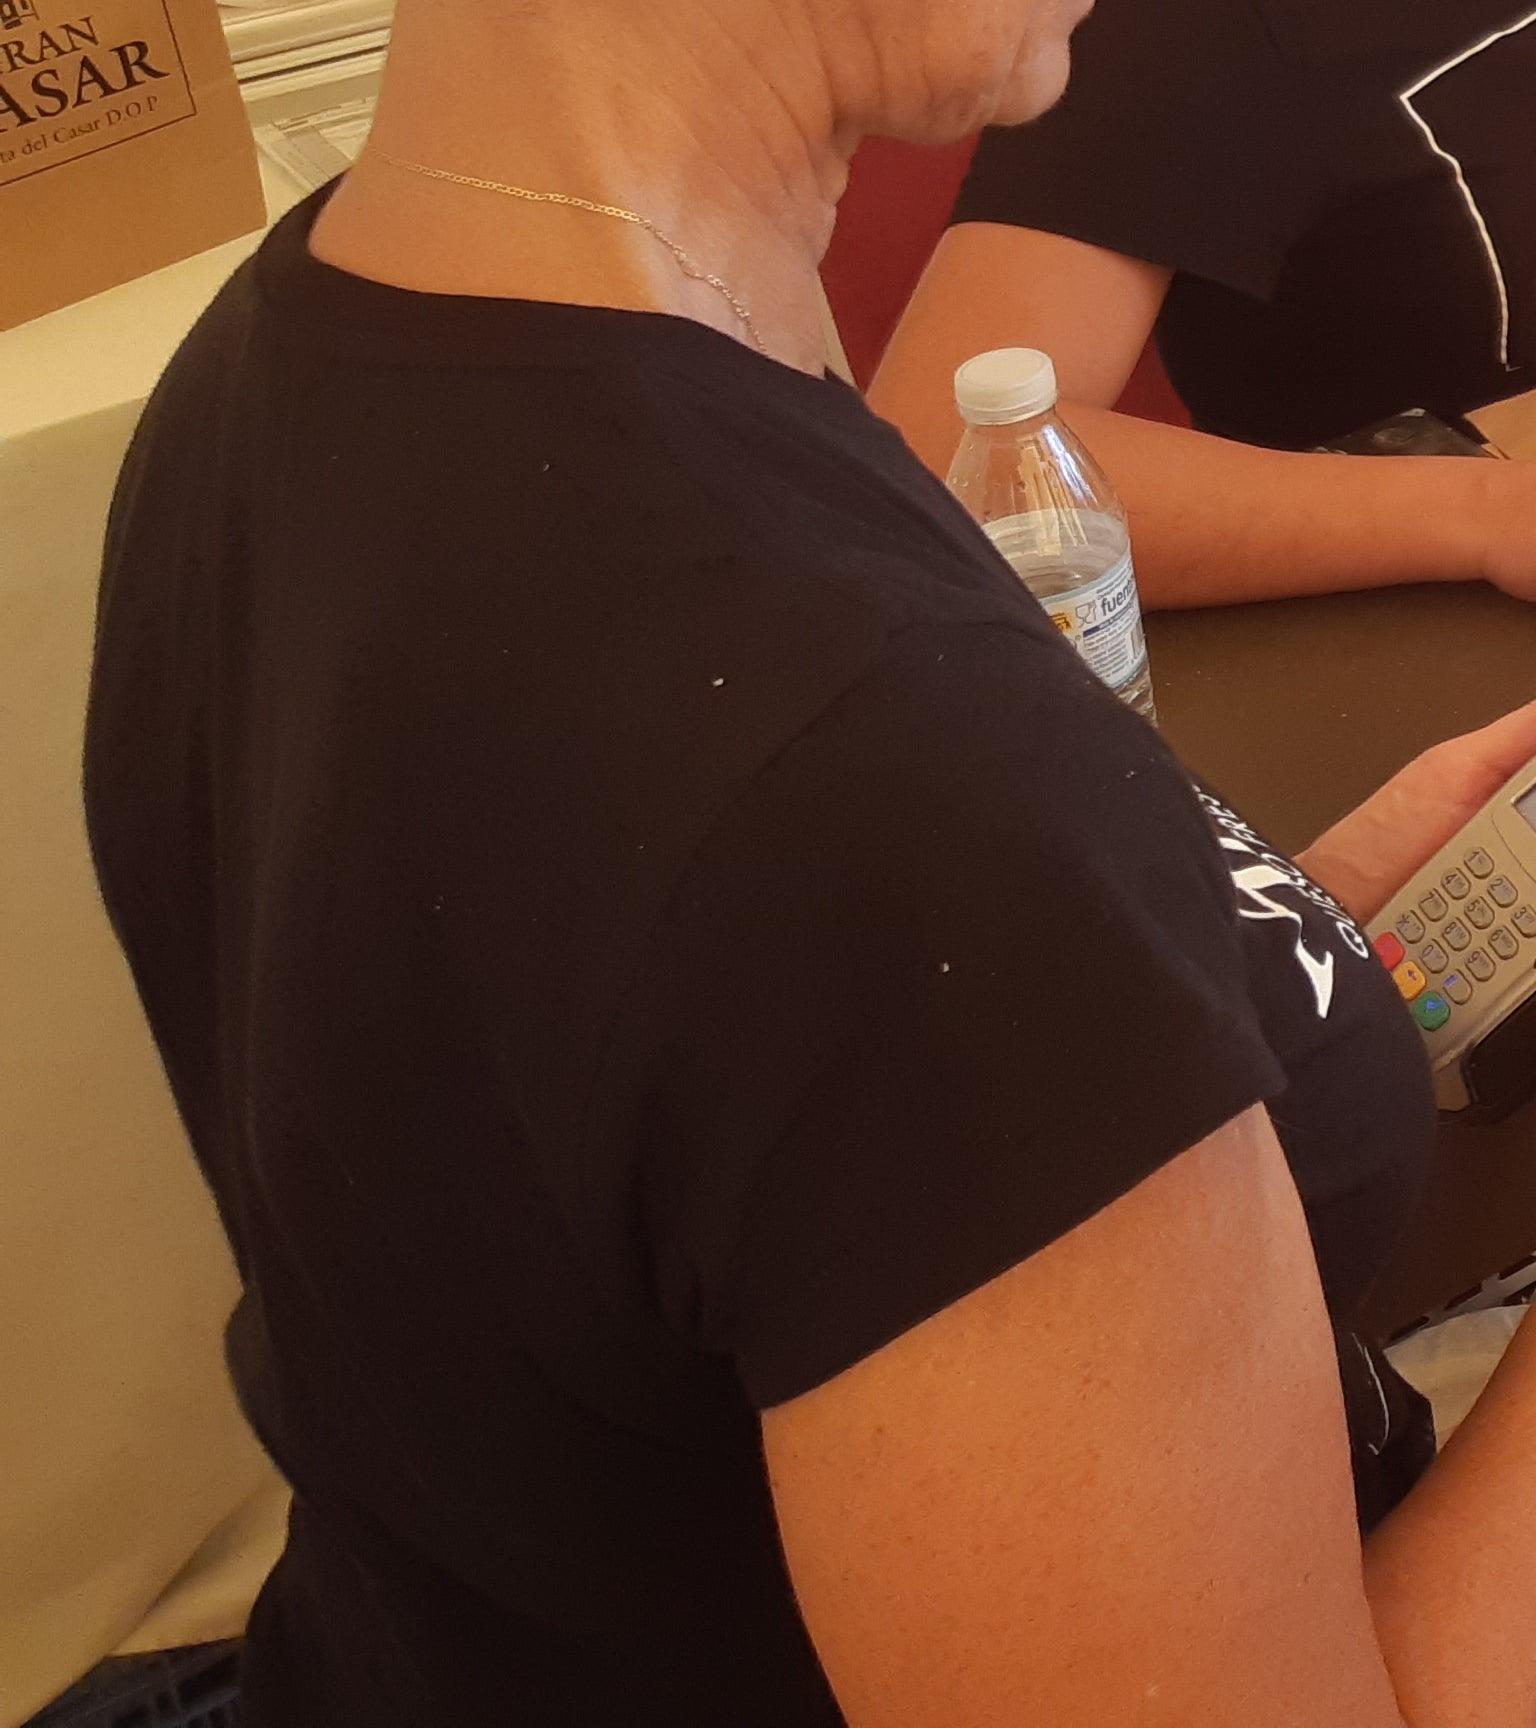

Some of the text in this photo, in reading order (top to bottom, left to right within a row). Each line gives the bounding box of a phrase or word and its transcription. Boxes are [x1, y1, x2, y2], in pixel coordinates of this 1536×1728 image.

[5, 16, 101, 73] RAN
[0, 38, 171, 135] ASAR
[21, 116, 102, 157] del Casar
